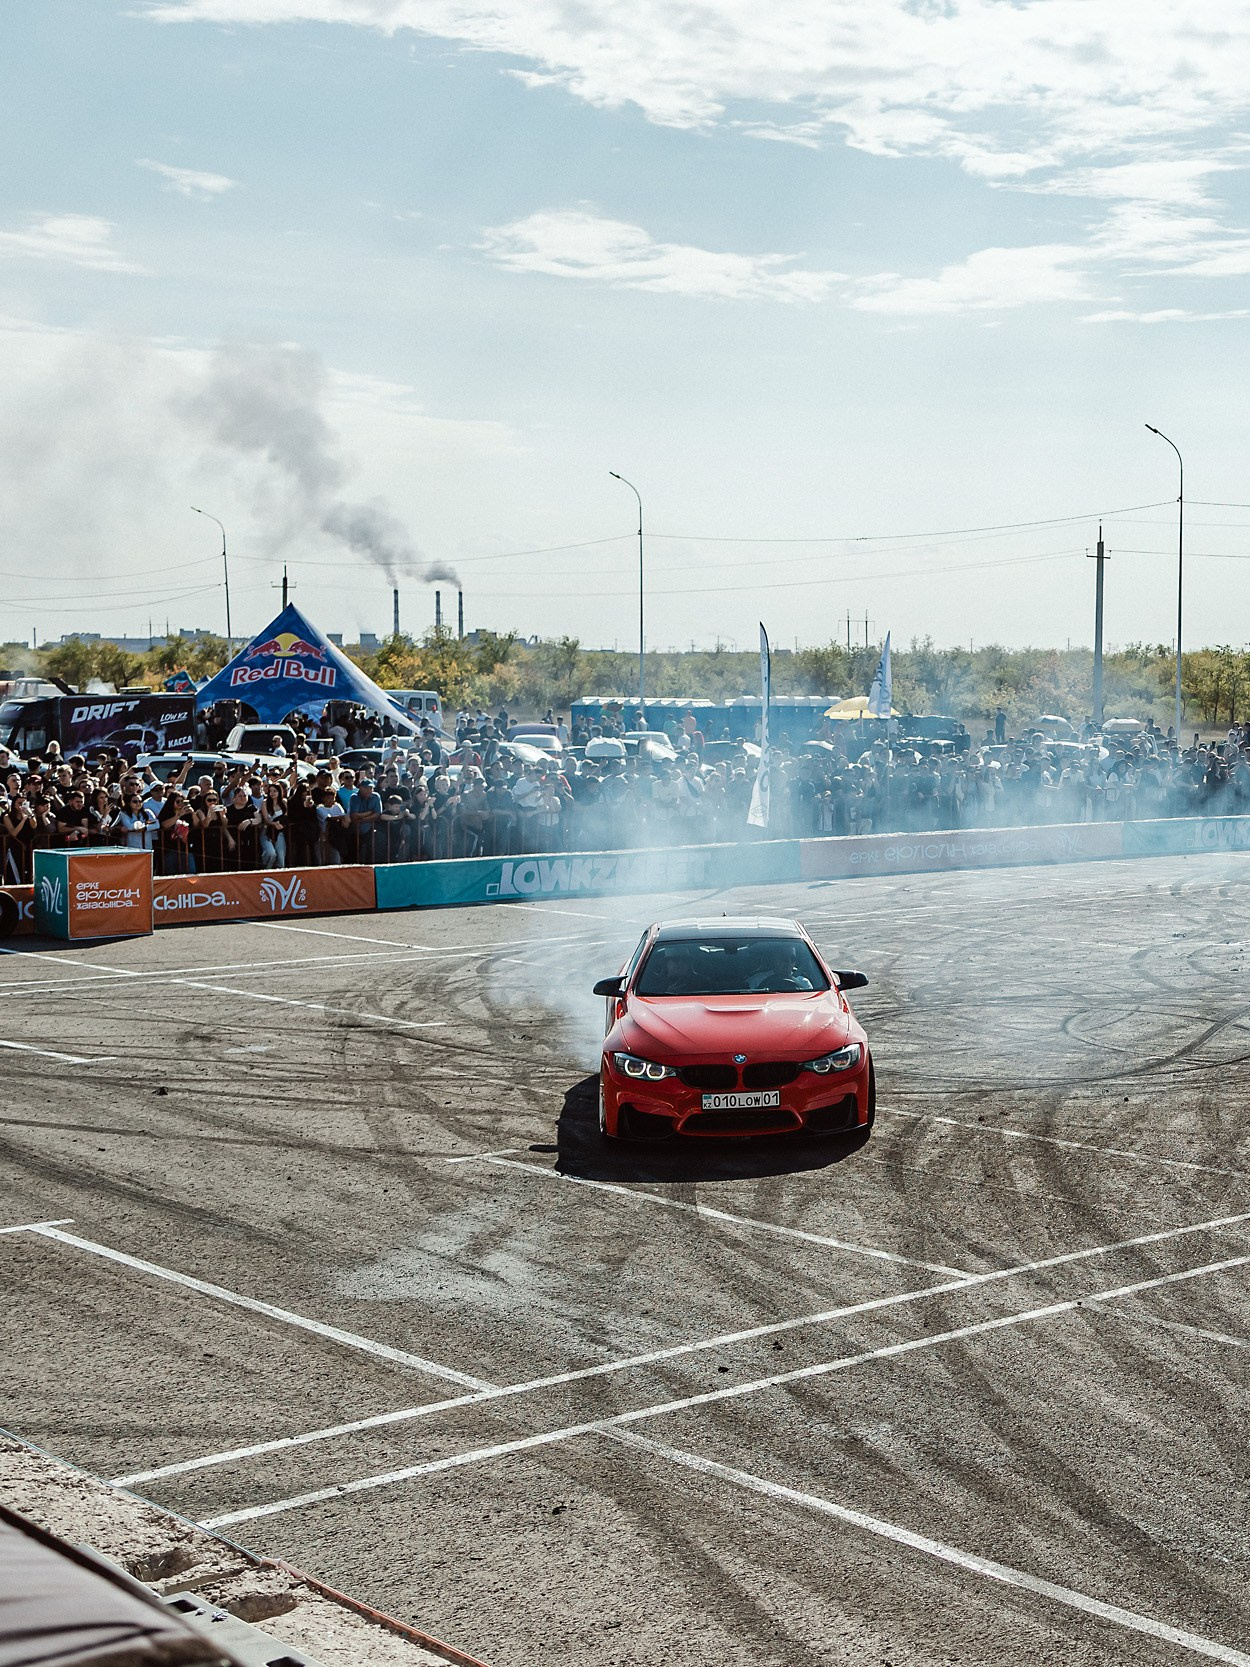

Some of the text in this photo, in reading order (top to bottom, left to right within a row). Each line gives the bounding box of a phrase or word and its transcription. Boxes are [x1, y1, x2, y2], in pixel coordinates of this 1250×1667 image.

[230, 658, 282, 687] Red
[283, 659, 337, 688] Bull
[70, 700, 140, 724] DRIFT
[763, 1092, 779, 1105] 01
